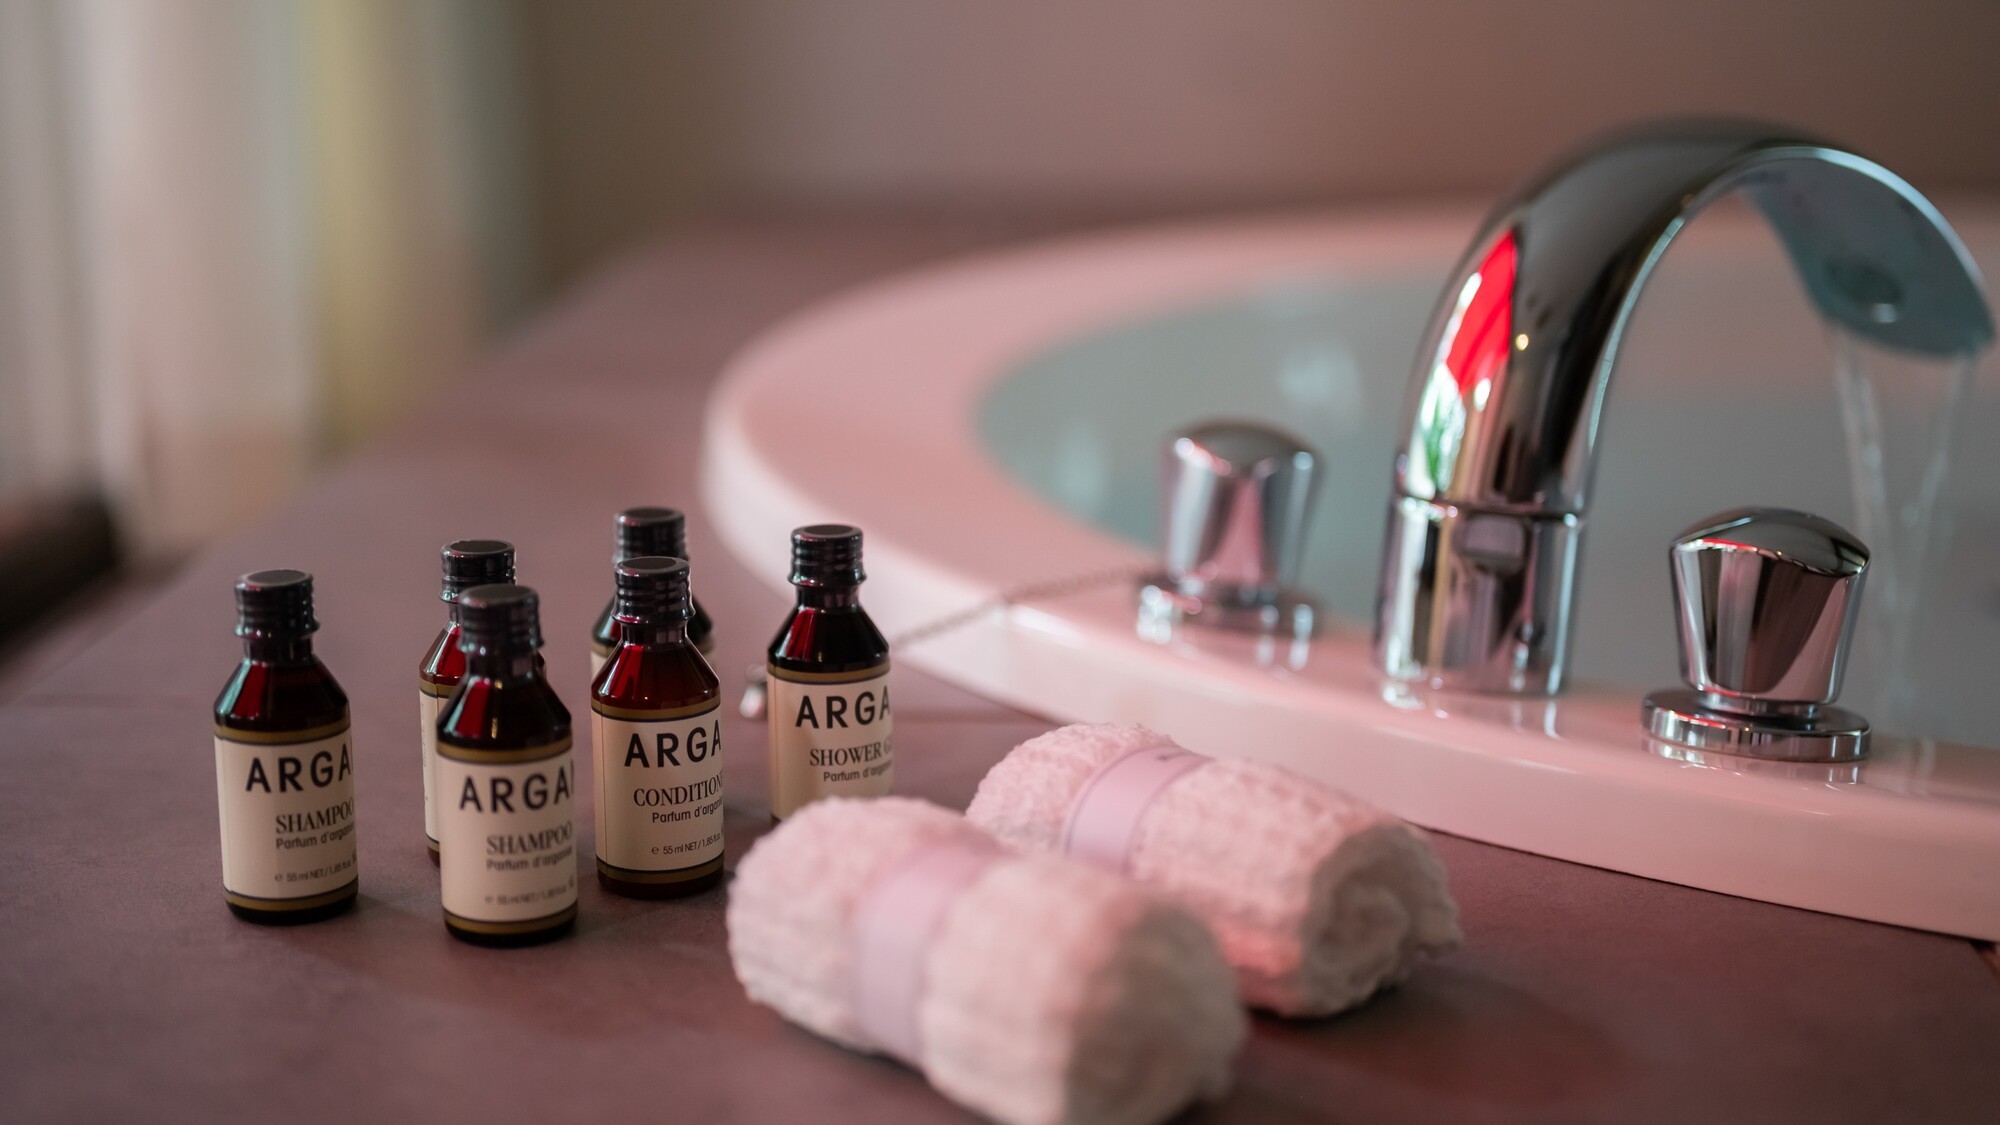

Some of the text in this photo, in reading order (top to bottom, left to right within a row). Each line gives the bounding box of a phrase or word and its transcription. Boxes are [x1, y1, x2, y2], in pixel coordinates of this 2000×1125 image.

[795, 685, 890, 729] ARGA
[624, 719, 722, 769] ARGA
[809, 742, 882, 767] SHOWER
[246, 738, 353, 794] ARGA
[823, 771, 860, 782] Parfum
[459, 759, 575, 813] ARGA
[275, 797, 355, 834] SHAMPOO
[652, 811, 691, 823] Parfum
[276, 836, 318, 850] Parfum
[486, 821, 573, 855] SHAMPOO
[663, 845, 673, 855] 55
[674, 844, 684, 854] ml
[685, 841, 698, 851] NET
[486, 858, 529, 872] Parfum
